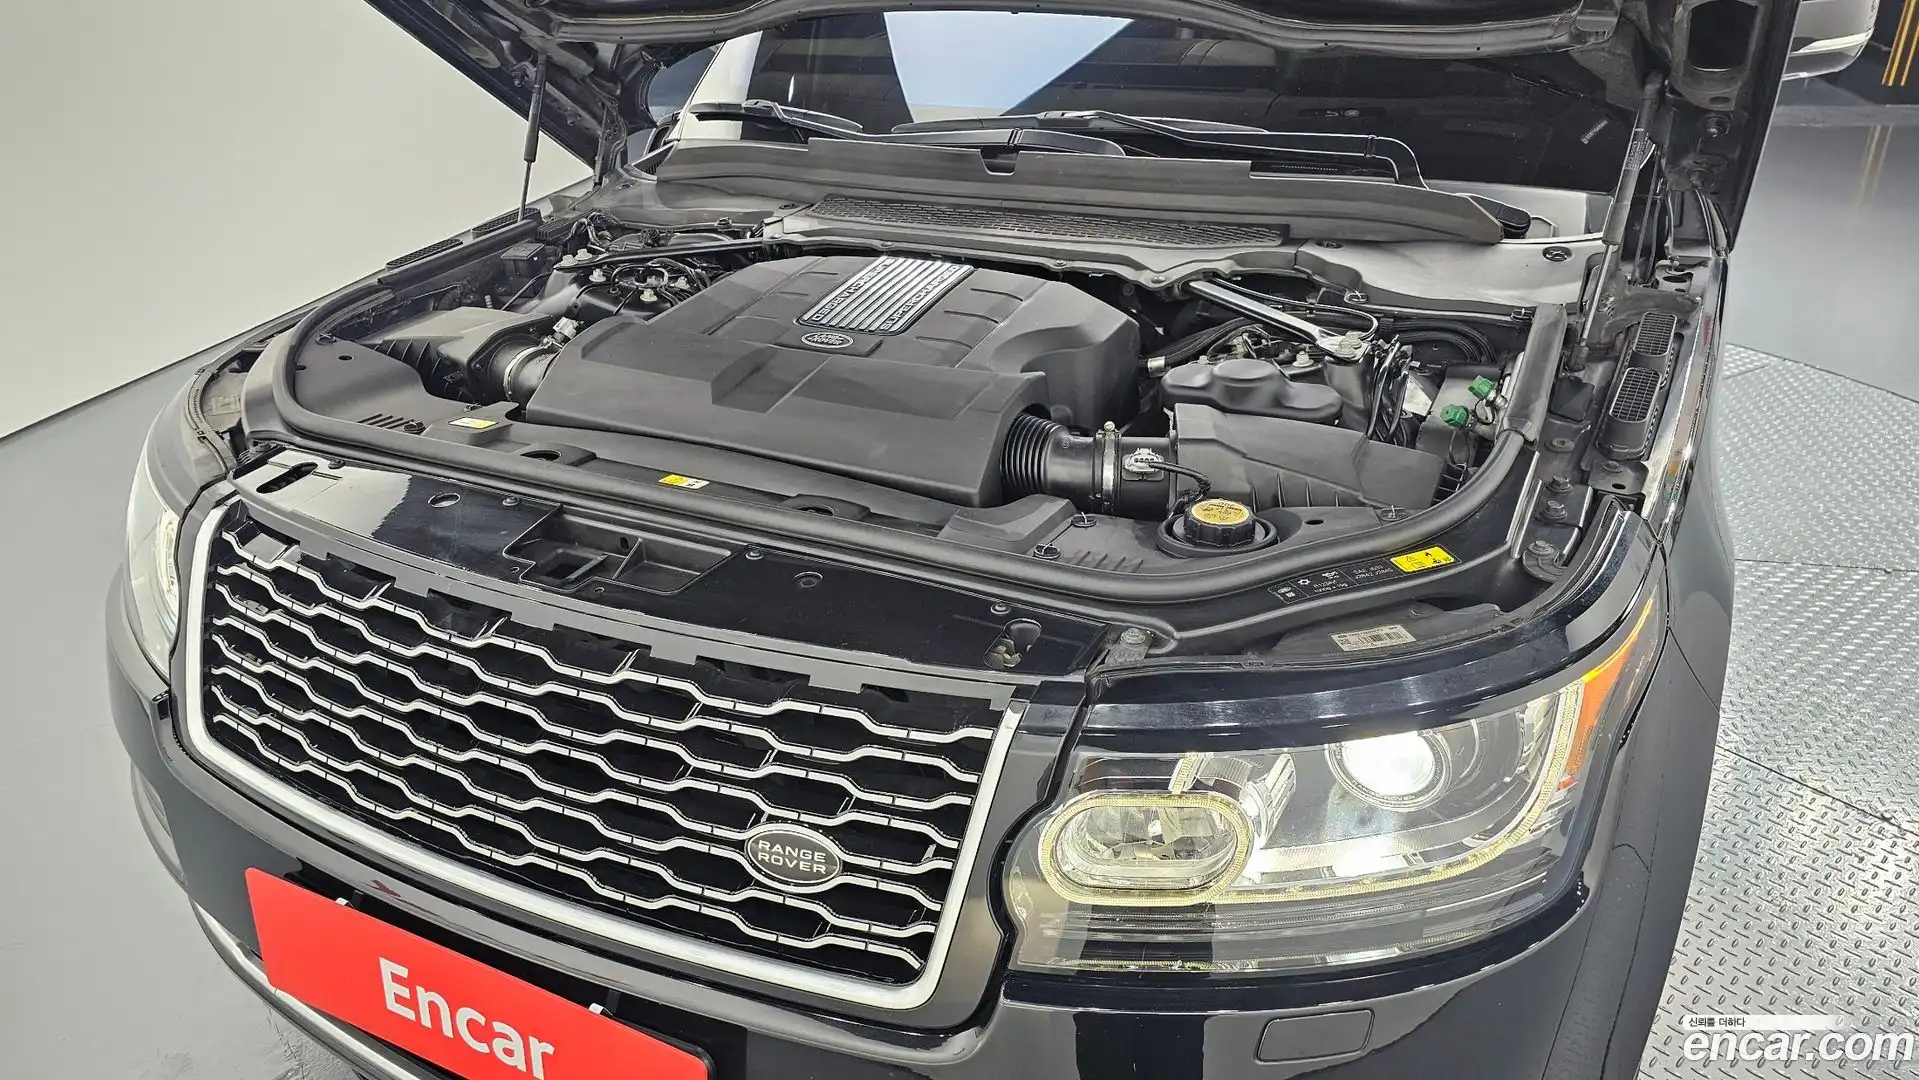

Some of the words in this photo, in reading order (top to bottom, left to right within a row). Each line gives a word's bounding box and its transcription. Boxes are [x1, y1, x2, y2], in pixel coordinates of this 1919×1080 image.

[758, 840, 827, 862] RANGE
[758, 852, 827, 874] ROVER
[378, 957, 555, 1080] Encar
